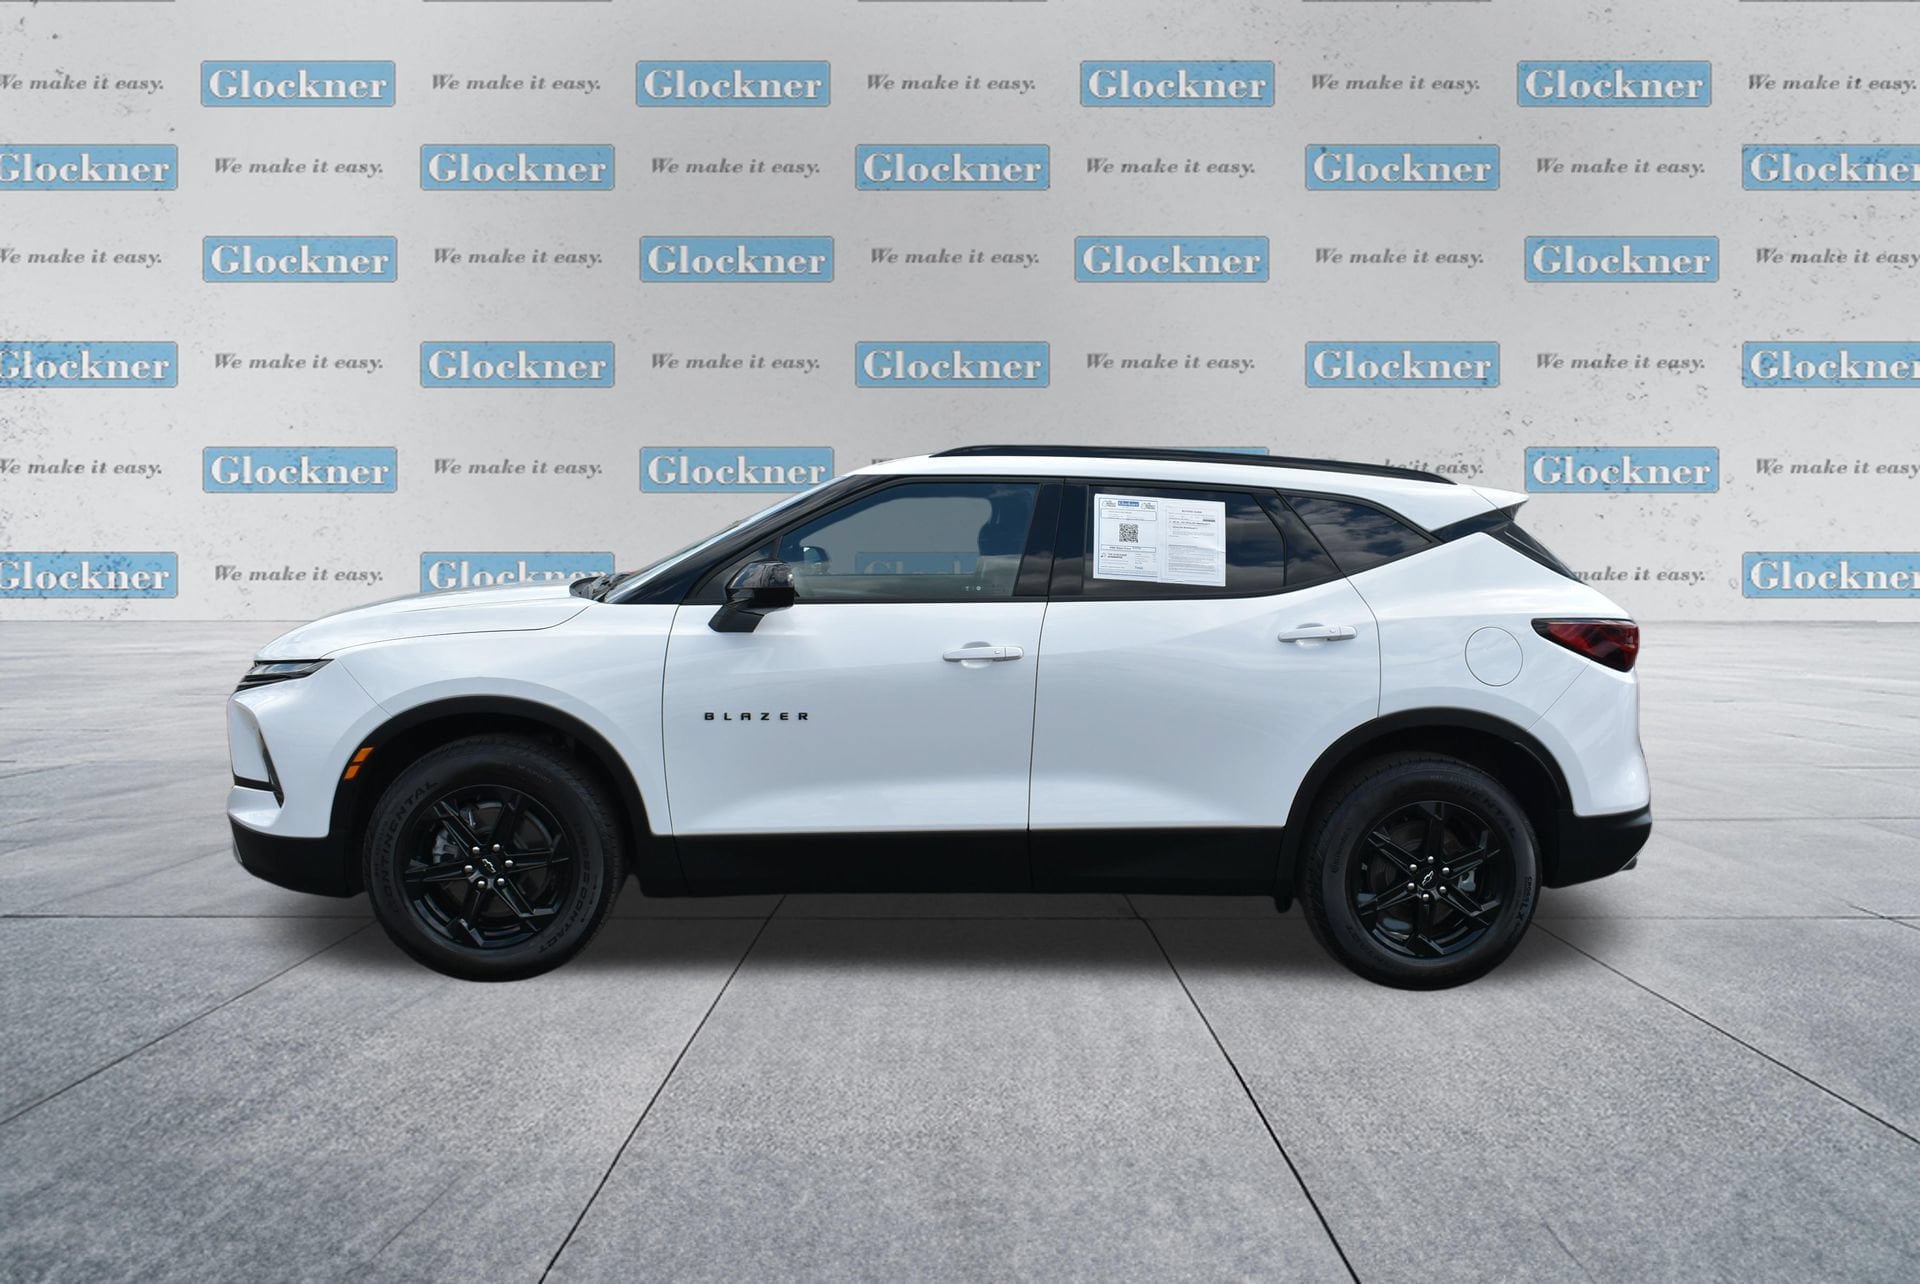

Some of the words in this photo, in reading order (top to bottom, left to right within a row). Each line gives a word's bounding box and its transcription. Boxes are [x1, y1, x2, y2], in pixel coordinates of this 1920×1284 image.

[29, 74, 87, 90] make
[93, 75, 109, 90] it
[115, 79, 164, 95] easy.
[209, 69, 387, 99] Glockner
[432, 74, 460, 90] We
[466, 74, 524, 90] make
[530, 75, 546, 90] it
[552, 79, 601, 95] easy.
[644, 69, 822, 99] Glockner
[867, 74, 895, 90] We
[901, 74, 959, 90] make
[965, 75, 981, 90] it
[987, 79, 1036, 95] easy.
[1088, 69, 1266, 99] Glockner
[1311, 74, 1339, 90] We
[1345, 74, 1403, 90] make
[1409, 75, 1425, 90] it
[1431, 79, 1480, 95] easy.
[1525, 69, 1703, 99] Glockner
[1748, 74, 1776, 90] We
[1782, 74, 1840, 90] make
[1846, 75, 1862, 90] it
[1868, 79, 1917, 95] easy.
[0, 153, 170, 183] Glockner
[214, 158, 242, 174] We
[248, 158, 306, 174] make
[312, 159, 328, 174] it
[334, 163, 383, 179] easy.
[428, 153, 606, 183] Glockner
[651, 158, 679, 174] We
[685, 158, 743, 174] make
[749, 159, 765, 174] it
[771, 163, 820, 179] easy.
[863, 153, 1041, 183] Glockner
[1086, 158, 1114, 174] We
[1120, 158, 1178, 174] make
[1184, 159, 1200, 174] it
[1206, 163, 1255, 179] easy.
[1313, 153, 1491, 183] Glockner
[1536, 158, 1564, 174] We
[1570, 158, 1628, 174] make
[1634, 159, 1650, 174] it
[1656, 163, 1705, 179] easy.
[27, 248, 85, 264] make
[91, 249, 107, 264] it
[113, 253, 162, 269] easy.
[211, 245, 389, 275] Glockner
[434, 248, 462, 264] We
[468, 248, 526, 264] make
[532, 249, 548, 264] it
[554, 253, 603, 269] easy.
[648, 245, 826, 275] Glockner
[871, 248, 899, 264] We
[905, 248, 963, 264] make
[969, 249, 985, 264] it
[991, 253, 1040, 269] easy.
[1083, 245, 1261, 275] Glockner
[1315, 248, 1343, 264] We
[1349, 248, 1407, 264] make
[1413, 249, 1429, 264] it
[1435, 253, 1484, 269] easy.
[1533, 245, 1711, 275] Glockner
[1756, 248, 1784, 264] We
[1790, 248, 1848, 264] make
[1854, 249, 1870, 264] it
[0, 350, 169, 380] Glockner
[214, 353, 242, 369] We
[248, 353, 306, 369] make
[312, 354, 328, 369] it
[334, 358, 383, 374] easy.
[428, 350, 606, 380] Glockner
[651, 353, 679, 369] We
[685, 353, 743, 369] make
[749, 354, 765, 369] it
[771, 358, 820, 374] easy.
[863, 350, 1041, 380] Glockner
[1086, 353, 1114, 369] We
[1120, 353, 1178, 369] make
[1184, 354, 1200, 369] it
[1206, 358, 1255, 374] easy.
[1313, 350, 1491, 380] Glockner
[1536, 353, 1564, 369] We
[1570, 353, 1628, 369] make
[1634, 354, 1650, 369] it
[1656, 358, 1705, 374] easy.
[27, 458, 85, 474] make
[91, 459, 107, 474] it
[113, 463, 162, 479] easy.
[211, 455, 389, 485] Glockner
[434, 458, 462, 474] We
[468, 458, 526, 474] make
[532, 459, 548, 474] it
[554, 463, 603, 479] easy.
[648, 455, 826, 485] Glockner
[1435, 463, 1484, 479] easy.
[1533, 455, 1711, 485] Glockner
[1756, 458, 1784, 474] We
[1790, 458, 1848, 474] make
[1854, 459, 1870, 474] it
[0, 560, 169, 590] Glockner
[215, 565, 243, 581] We
[249, 565, 307, 581] make
[313, 566, 329, 581] it
[335, 570, 384, 586] easy.
[1634, 566, 1650, 581] it
[1656, 570, 1705, 586] easy.
[704, 712, 808, 720] BLAZER
